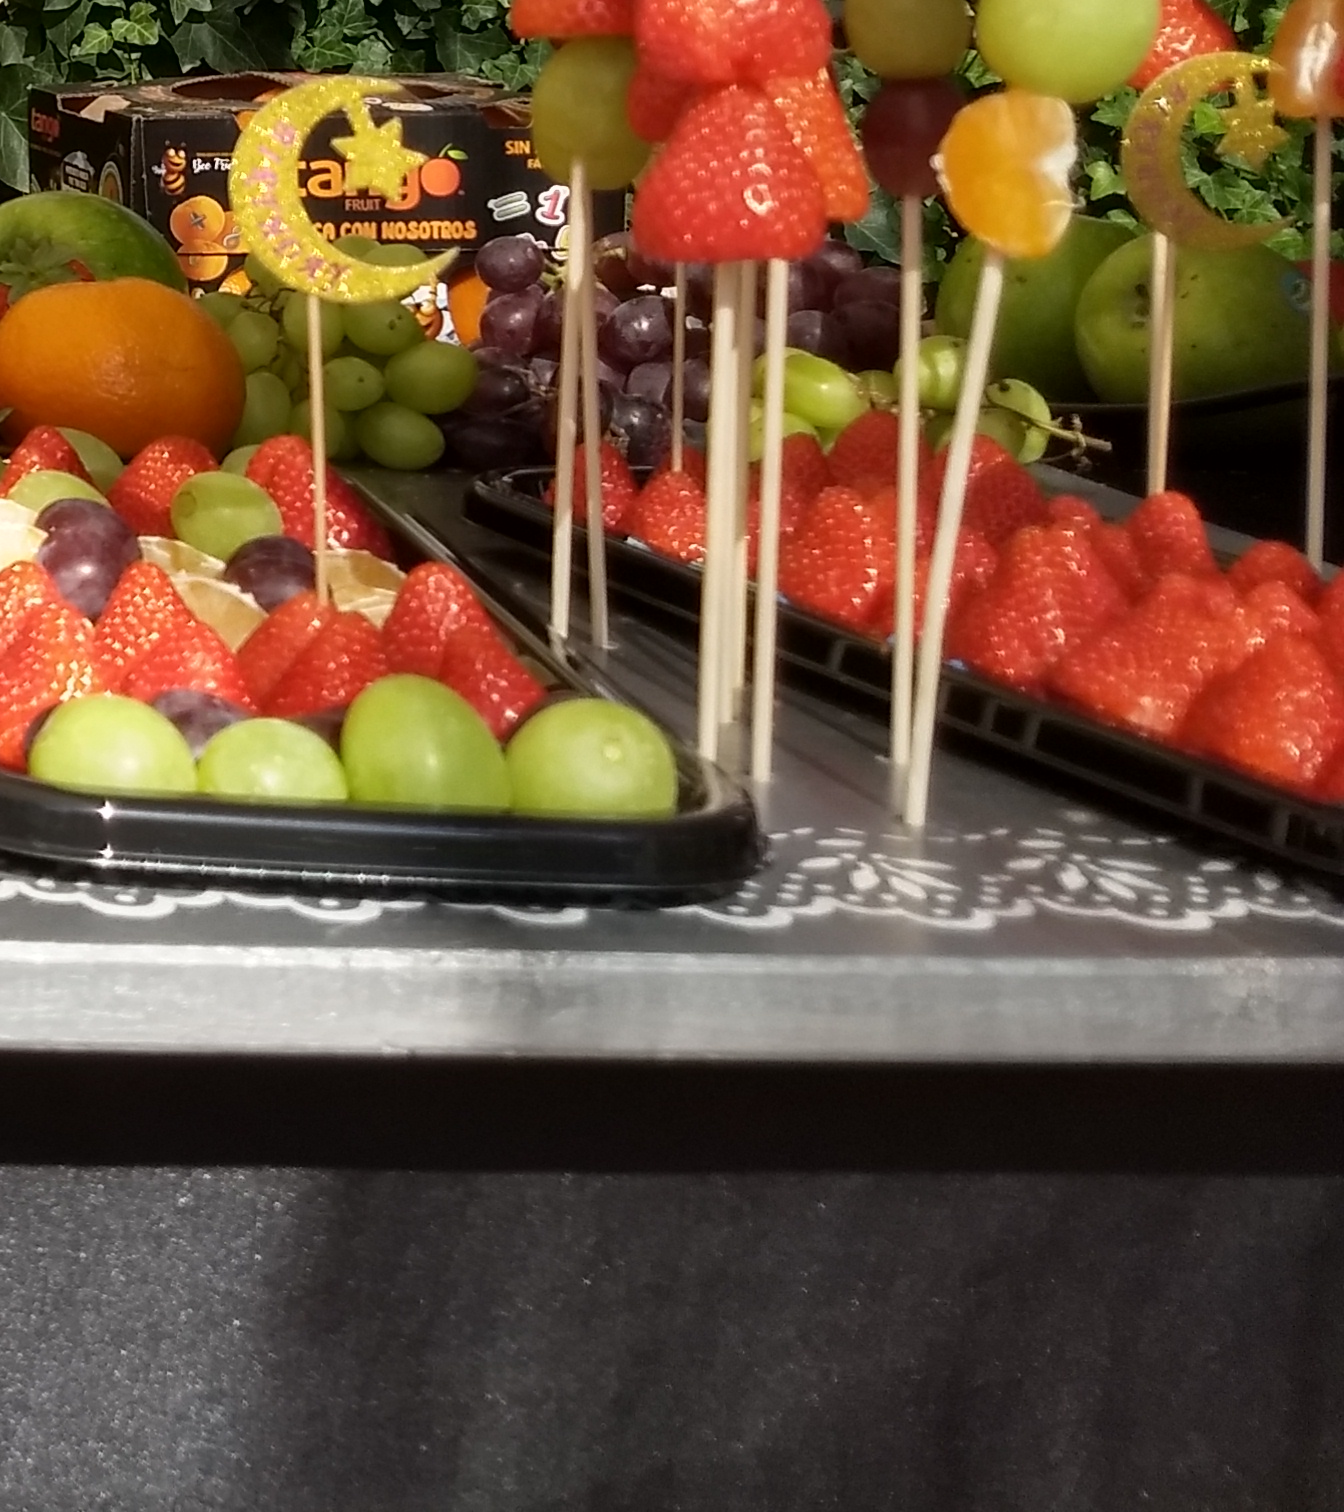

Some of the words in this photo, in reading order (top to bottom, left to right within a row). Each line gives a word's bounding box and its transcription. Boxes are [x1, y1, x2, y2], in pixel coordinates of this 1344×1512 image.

[504, 140, 531, 155] SIN
[192, 157, 211, 174] Bee
[344, 198, 381, 212] FRUIT
[339, 221, 378, 239] CON
[380, 220, 478, 239] NOSOTROS
